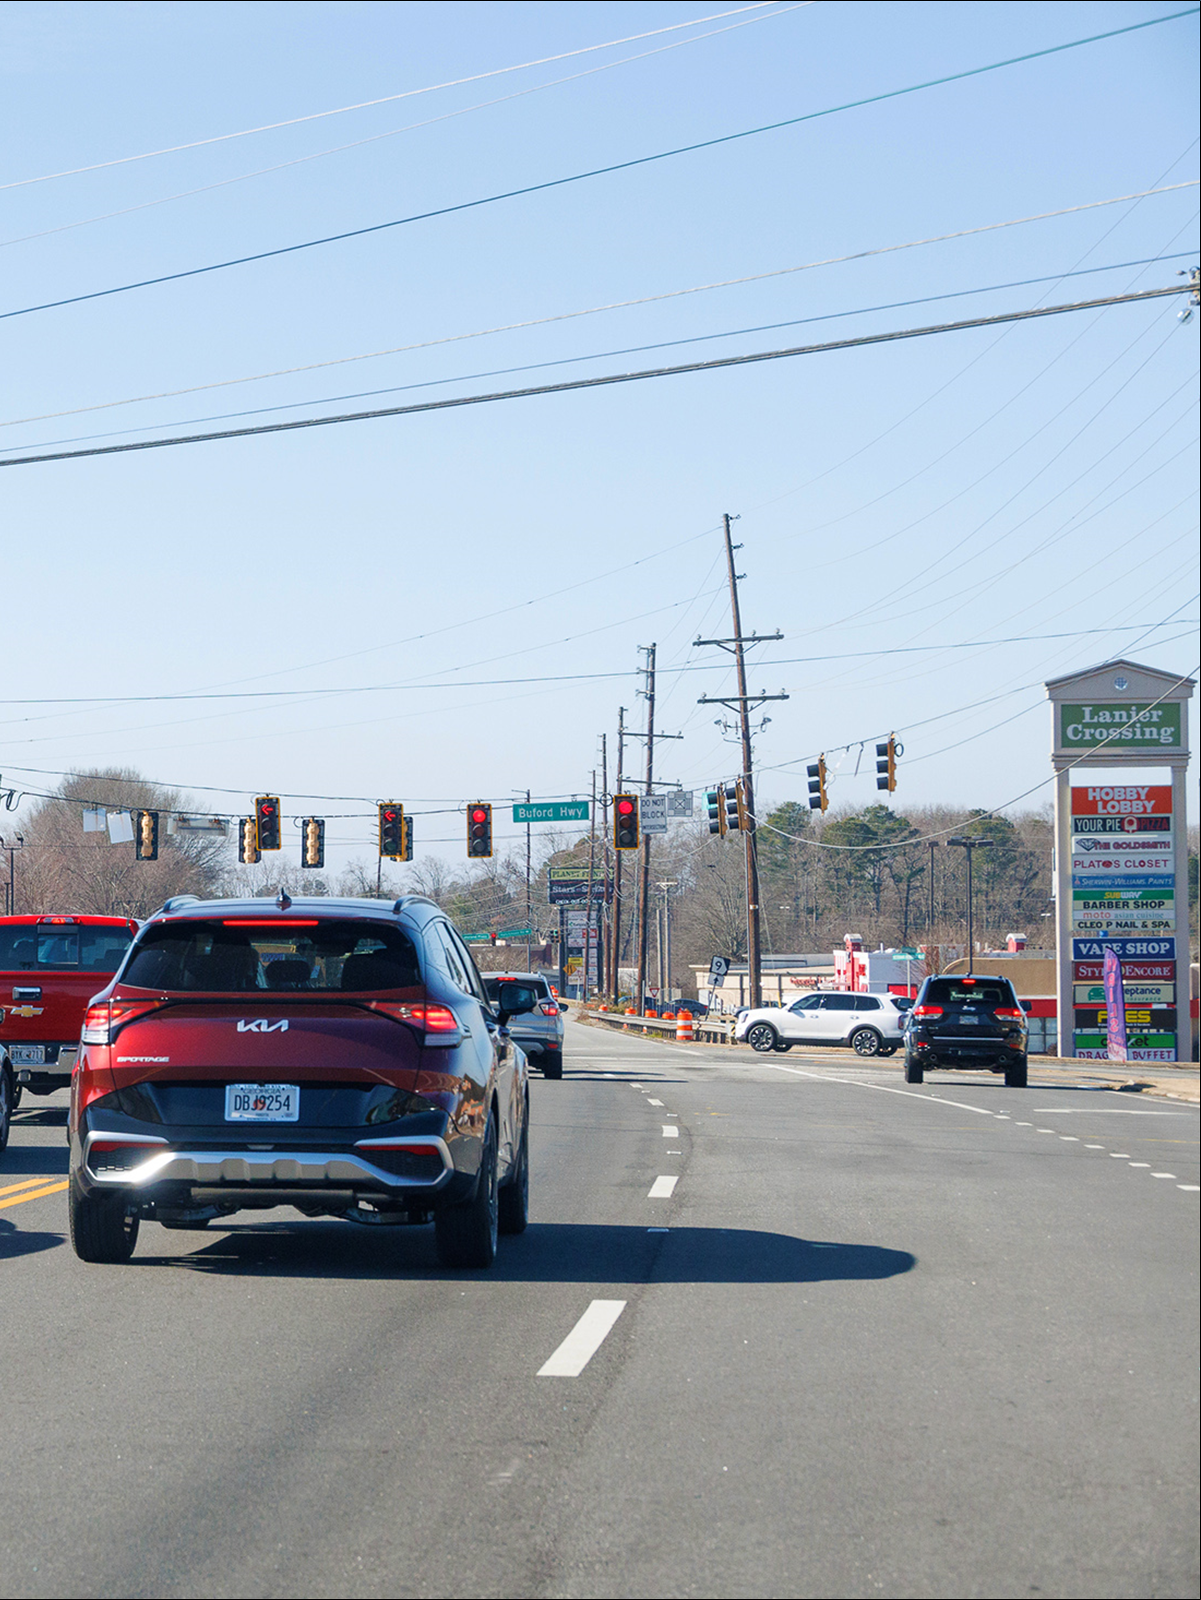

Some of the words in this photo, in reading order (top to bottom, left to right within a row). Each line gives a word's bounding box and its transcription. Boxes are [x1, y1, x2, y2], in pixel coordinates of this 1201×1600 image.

[1082, 706, 1163, 723] Lanier
[1066, 723, 1175, 743] Crossing
[1088, 787, 1149, 800] HOBBY
[519, 807, 553, 819] Buford
[560, 806, 583, 819] Hwy
[1097, 800, 1155, 814] LOBBY
[641, 811, 665, 819] BLOCK
[1076, 819, 1103, 832] YOUR
[1106, 818, 1121, 831] PIE
[1141, 818, 1169, 830] PIZZA
[1113, 841, 1170, 850] GOLDSMITH
[1074, 860, 1120, 869] PLATO'S
[1124, 859, 1168, 869] CLOSET
[1103, 891, 1142, 899] SUBWAY
[1083, 901, 1130, 909] BARBER
[1133, 900, 1165, 909] SHOP
[1083, 911, 1111, 919] moto
[1078, 921, 1103, 929] CLEO
[1116, 921, 1138, 929] NAIL
[1126, 942, 1170, 954] SHOP
[715, 960, 722, 971] 9
[1079, 965, 1105, 977] STY
[1125, 965, 1171, 976] ENCORE
[1124, 987, 1161, 997] eptance
[1078, 1051, 1108, 1060] DRAG
[1132, 1050, 1173, 1060] BUFFET
[234, 1094, 290, 1111] DBJ9254
